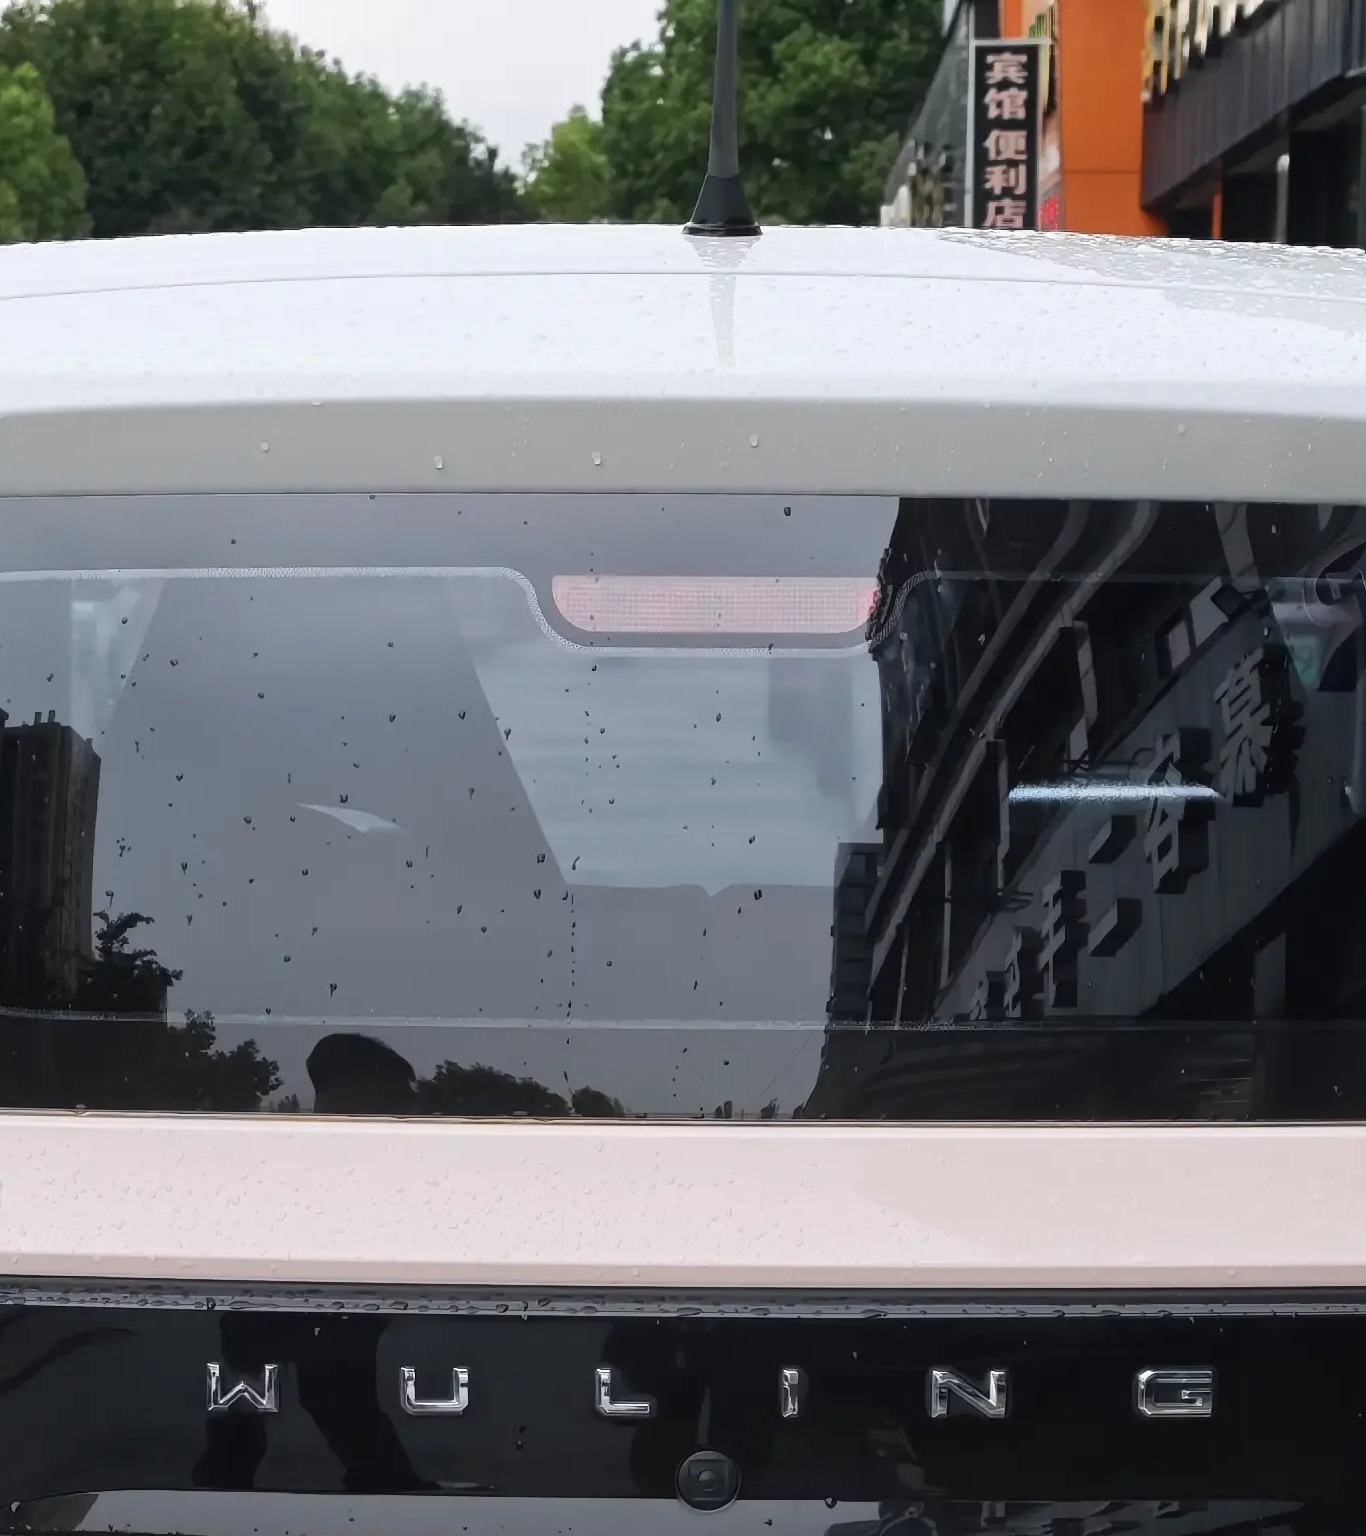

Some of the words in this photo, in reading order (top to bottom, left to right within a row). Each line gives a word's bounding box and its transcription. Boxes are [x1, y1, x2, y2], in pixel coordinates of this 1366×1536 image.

[981, 52, 1028, 229] 宾馆便利店
[206, 1361, 1214, 1420] WULING
